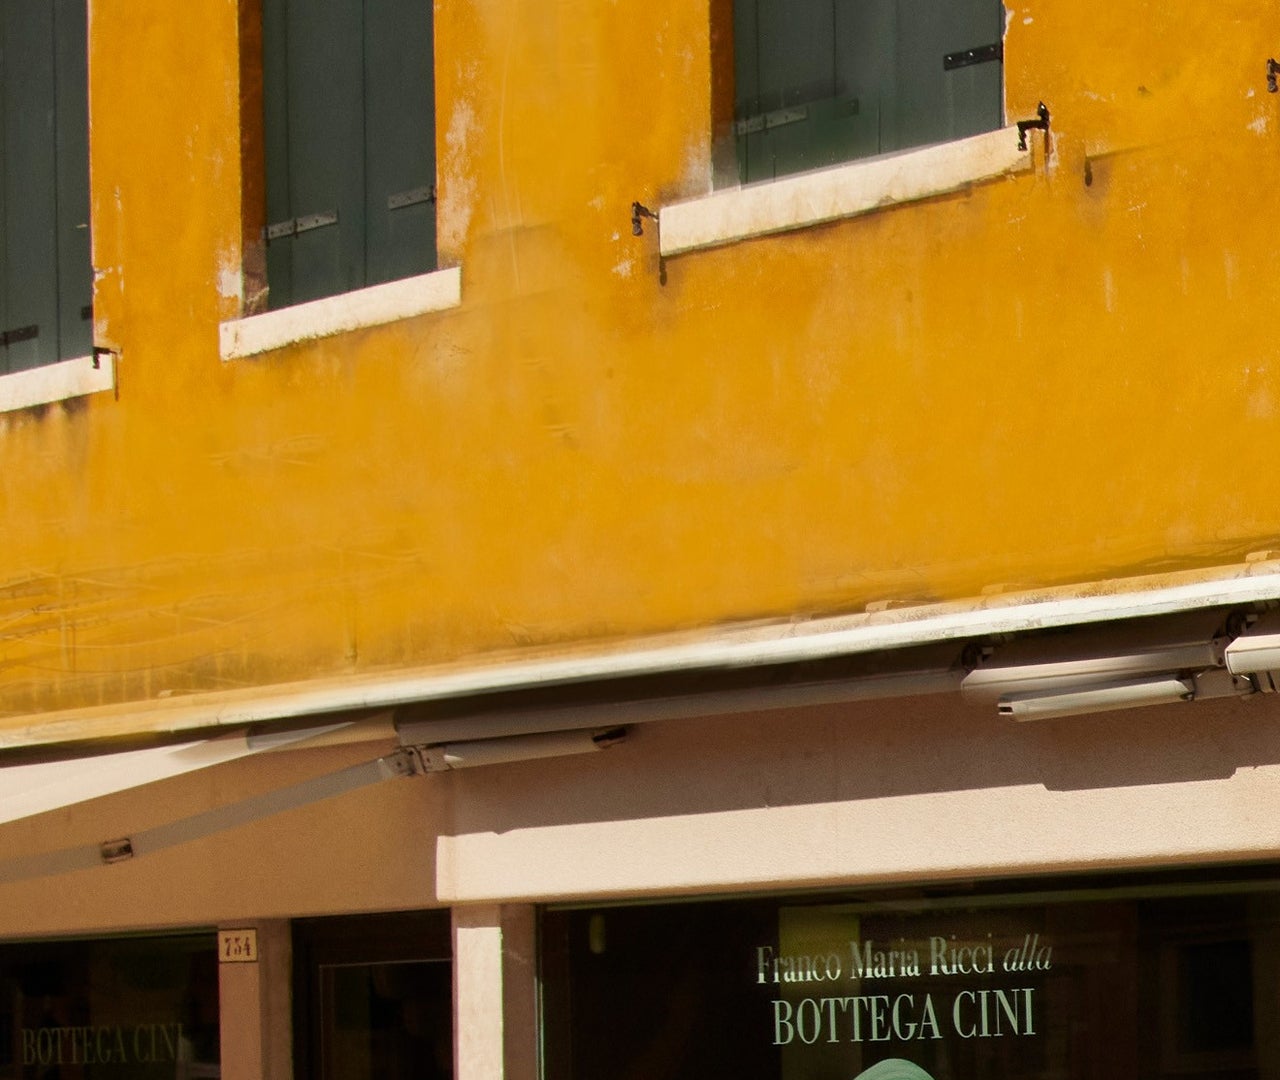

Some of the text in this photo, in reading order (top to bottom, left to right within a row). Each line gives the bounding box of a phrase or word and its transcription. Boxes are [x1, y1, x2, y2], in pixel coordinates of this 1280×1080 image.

[755, 932, 1053, 984] Franco Maria Ricci alla
[770, 988, 1036, 1046] BOTTEGA CINI
[22, 1026, 128, 1065] BOTTEGA
